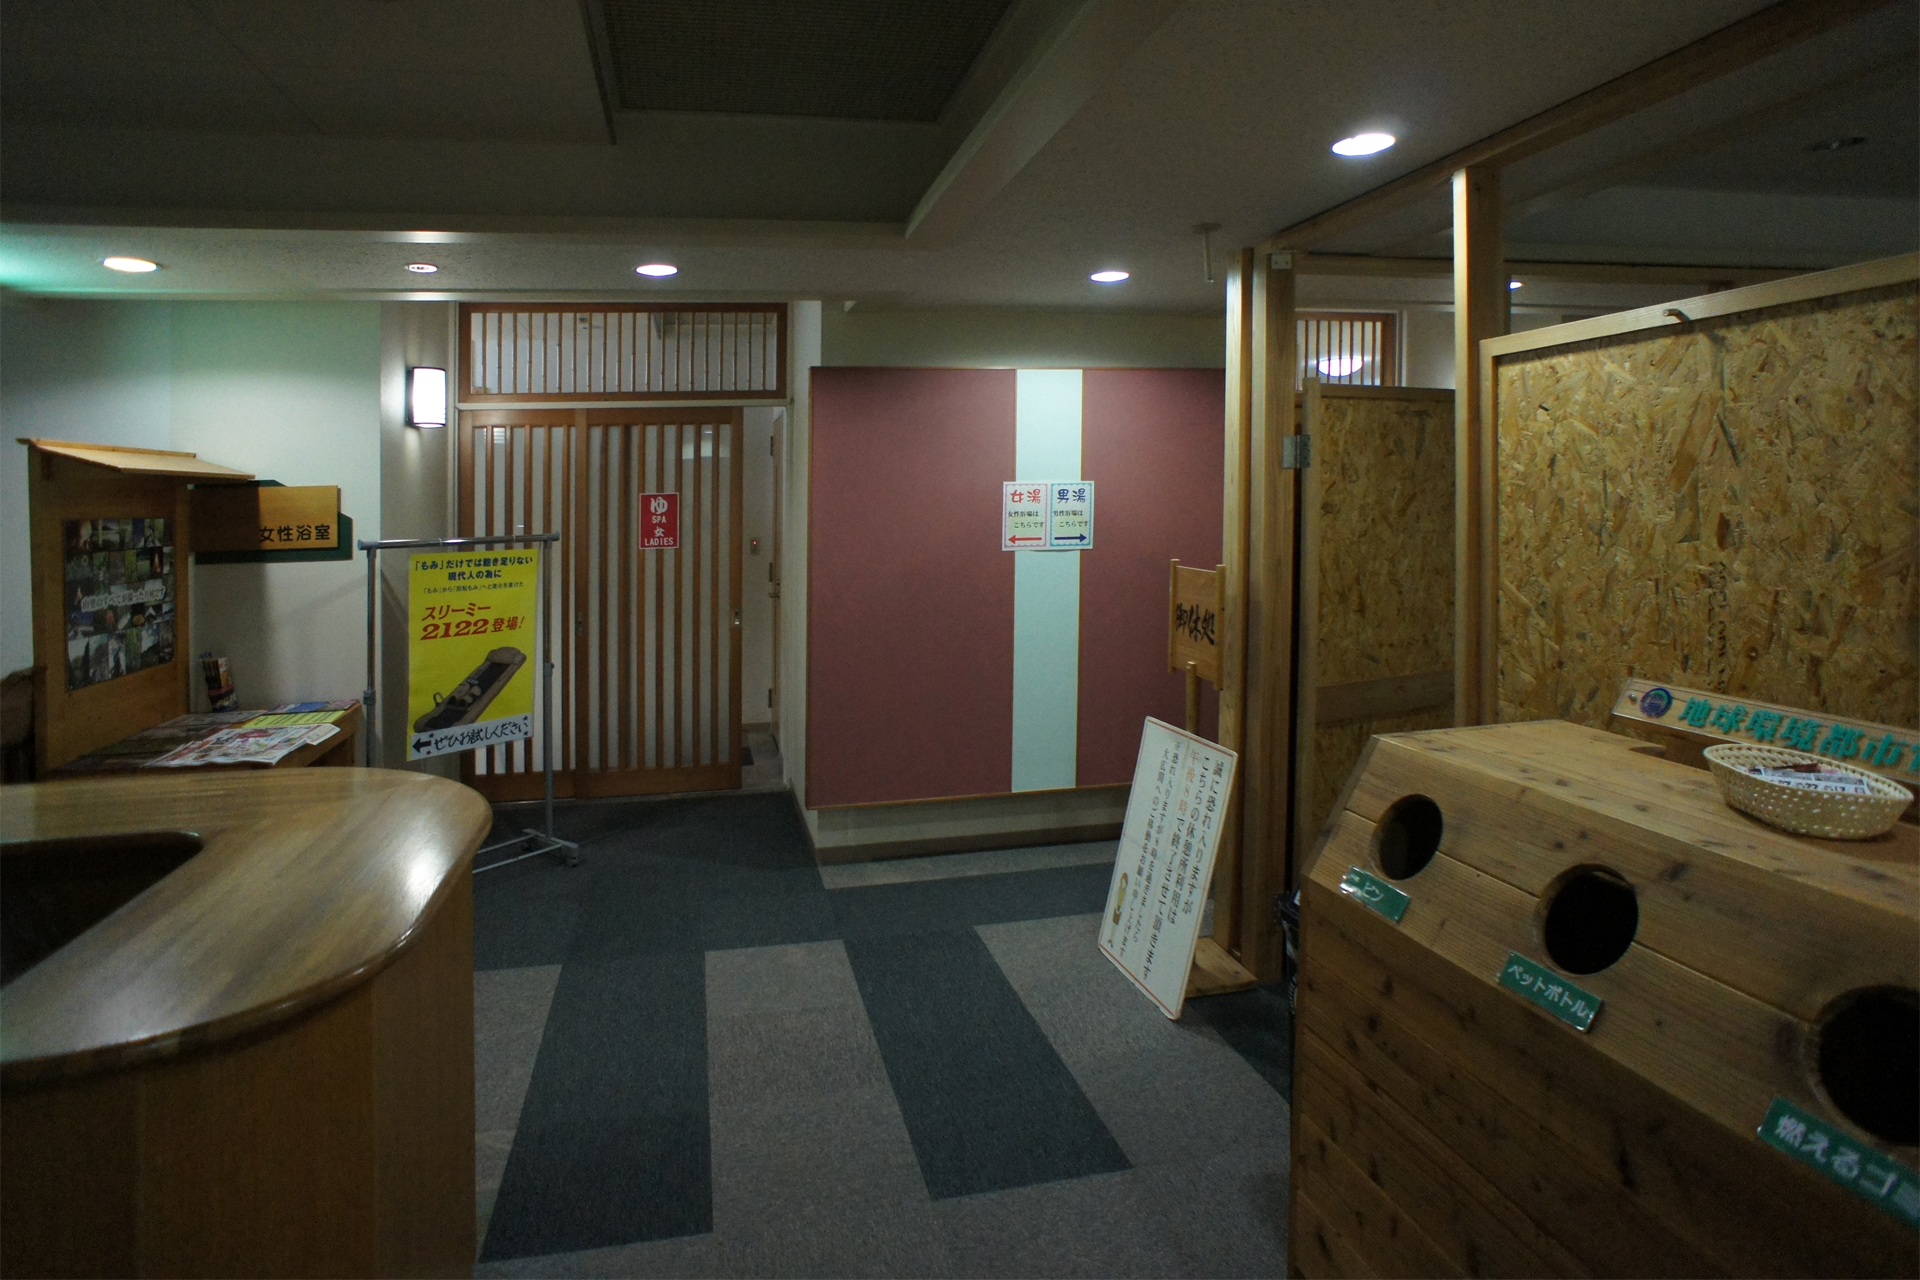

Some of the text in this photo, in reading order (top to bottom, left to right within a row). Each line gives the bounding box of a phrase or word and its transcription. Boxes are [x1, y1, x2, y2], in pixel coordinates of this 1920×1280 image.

[1010, 488, 1041, 504] 女湯
[1057, 488, 1086, 504] 男湯
[650, 496, 668, 515] ゆ
[651, 515, 667, 524] SPA
[1013, 521, 1045, 529] こちらです
[1059, 520, 1089, 528] こちらです
[259, 524, 331, 543] 女性浴室
[653, 526, 665, 537] 女
[644, 537, 674, 546] LADIES
[447, 569, 502, 581] 現代人の為に
[422, 603, 491, 622] スリーミー
[434, 723, 527, 750] ぜひお試しください
[1678, 697, 1920, 773] 地球環境都市
[1508, 965, 1590, 1018] ペットボトル
